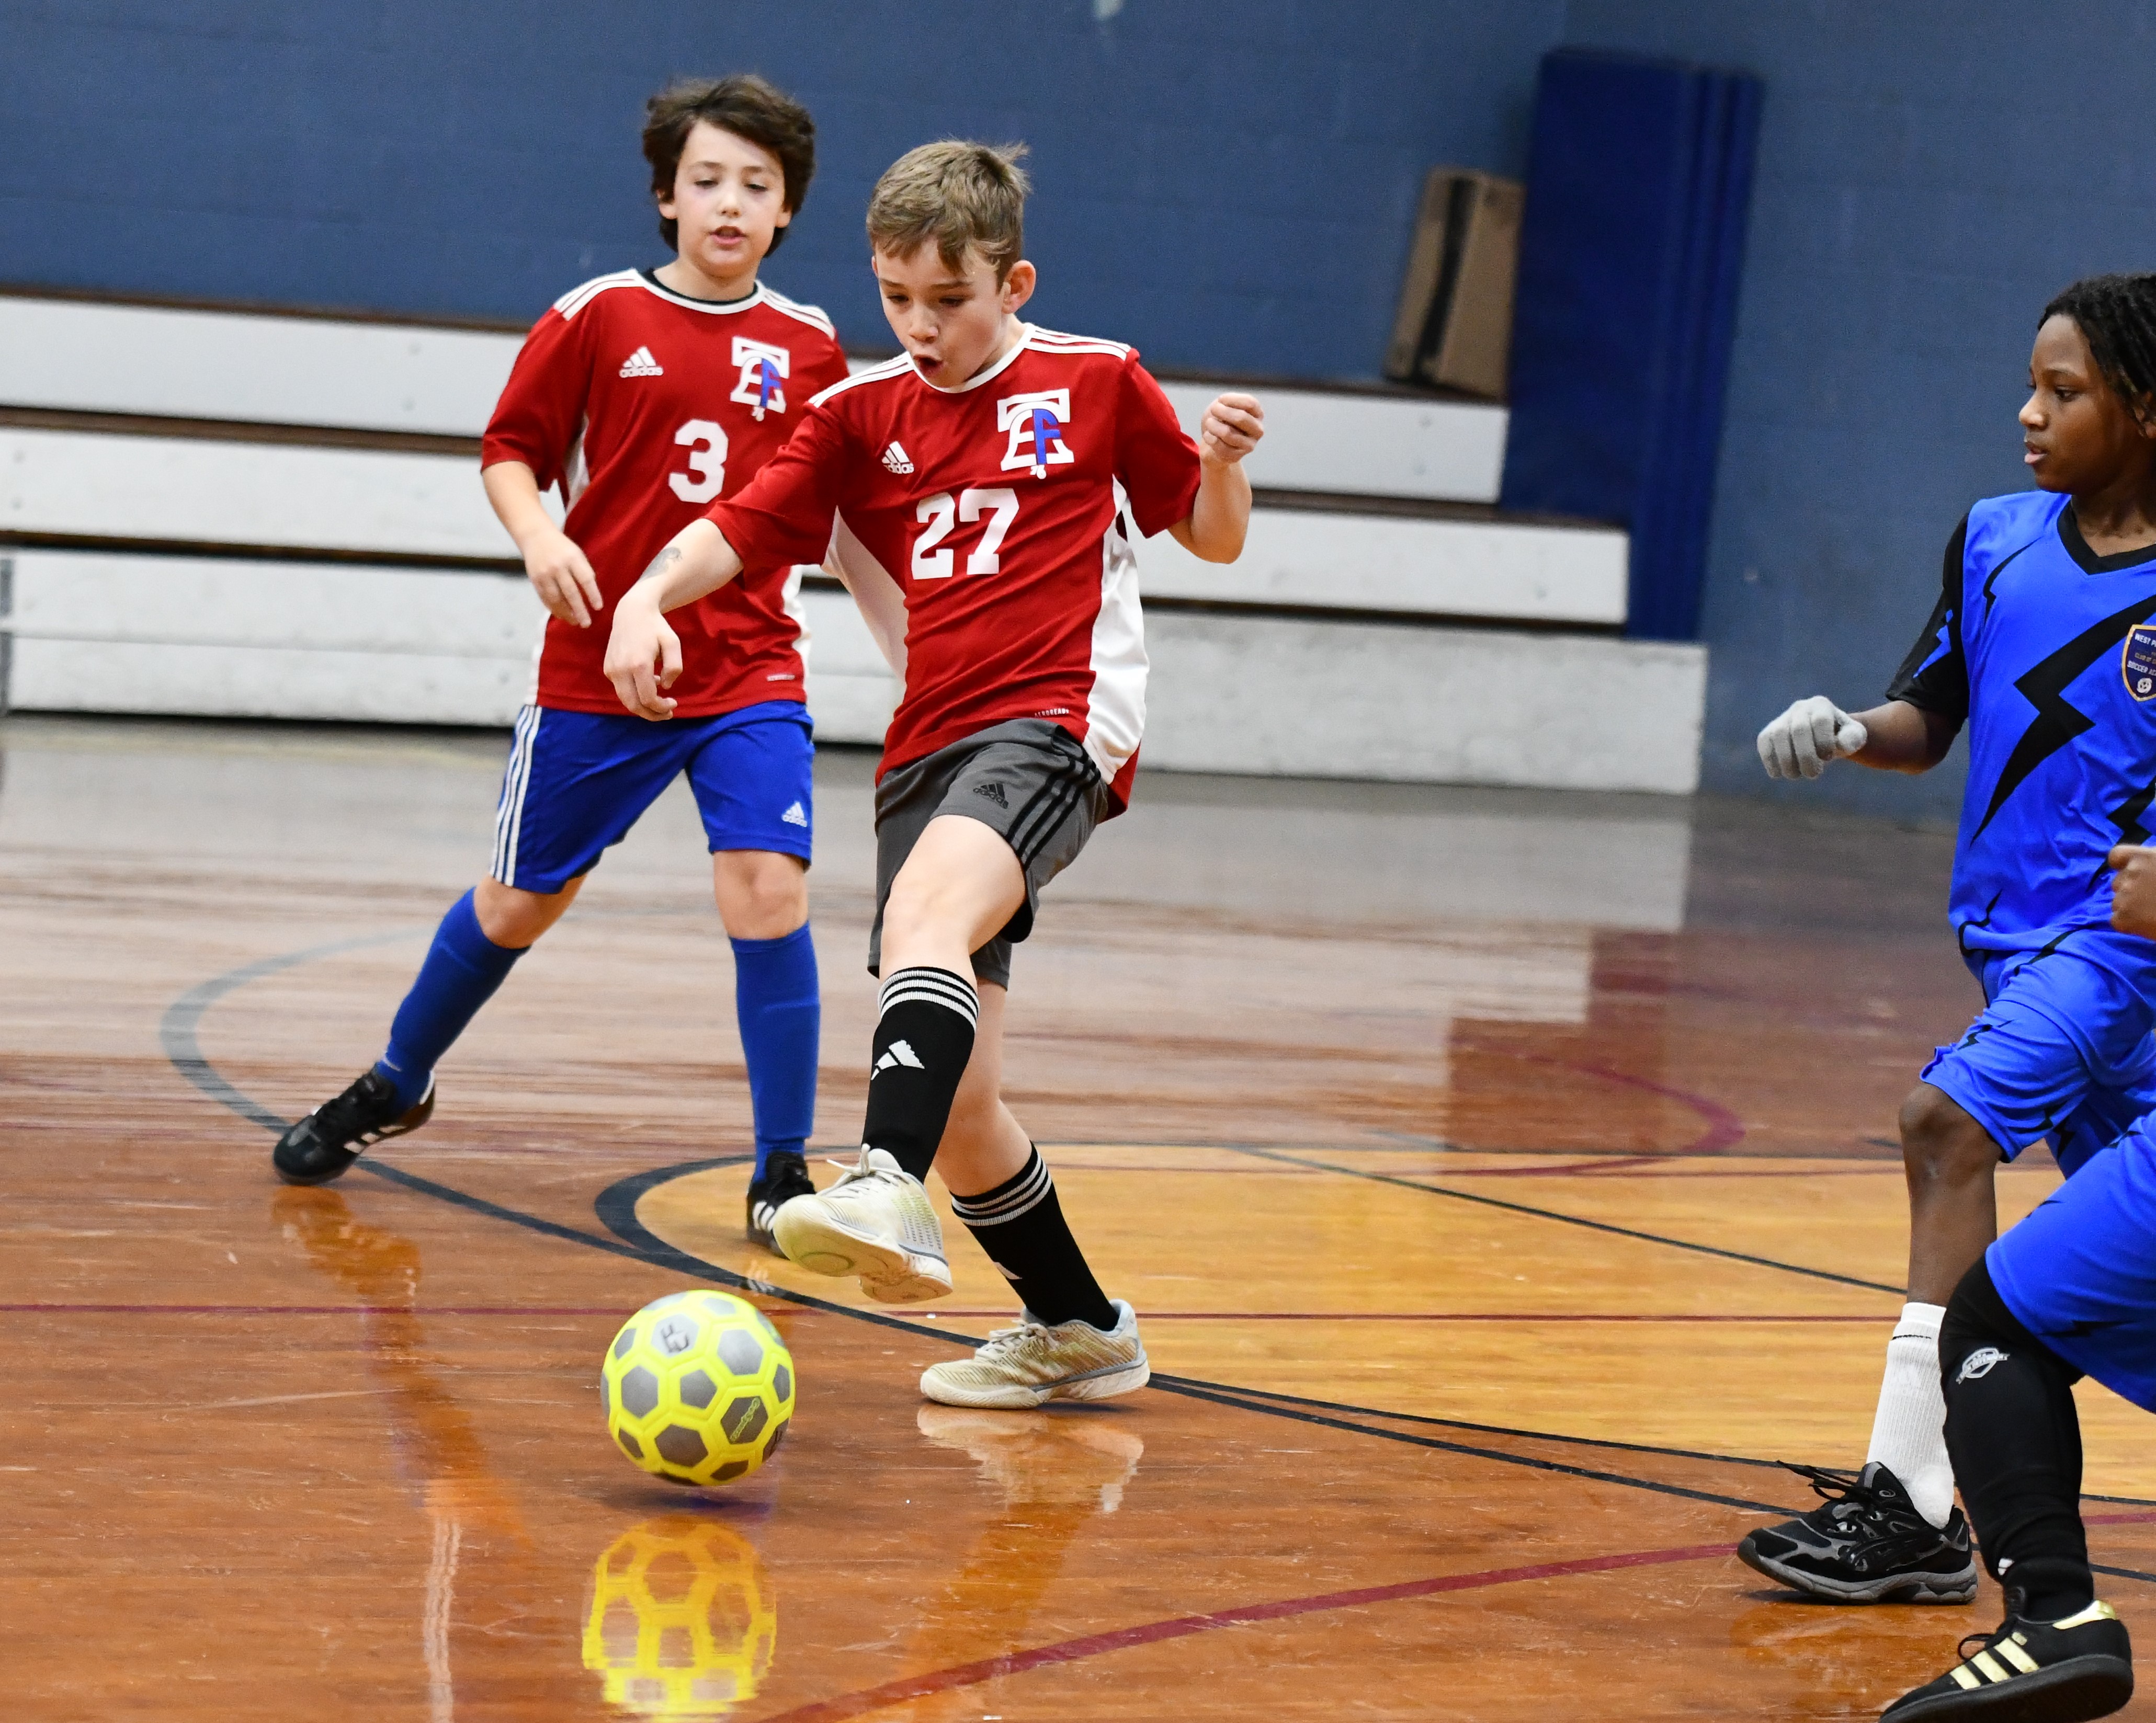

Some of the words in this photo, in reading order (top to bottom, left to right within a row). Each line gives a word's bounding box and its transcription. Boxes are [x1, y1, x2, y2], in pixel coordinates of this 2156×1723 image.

[618, 366, 663, 378] adidas
[667, 419, 729, 504] 3
[911, 488, 1019, 580] 27
[2135, 633, 2151, 645] WEST
[2127, 661, 2149, 674] SOCCER
[973, 788, 1009, 809] adidas
